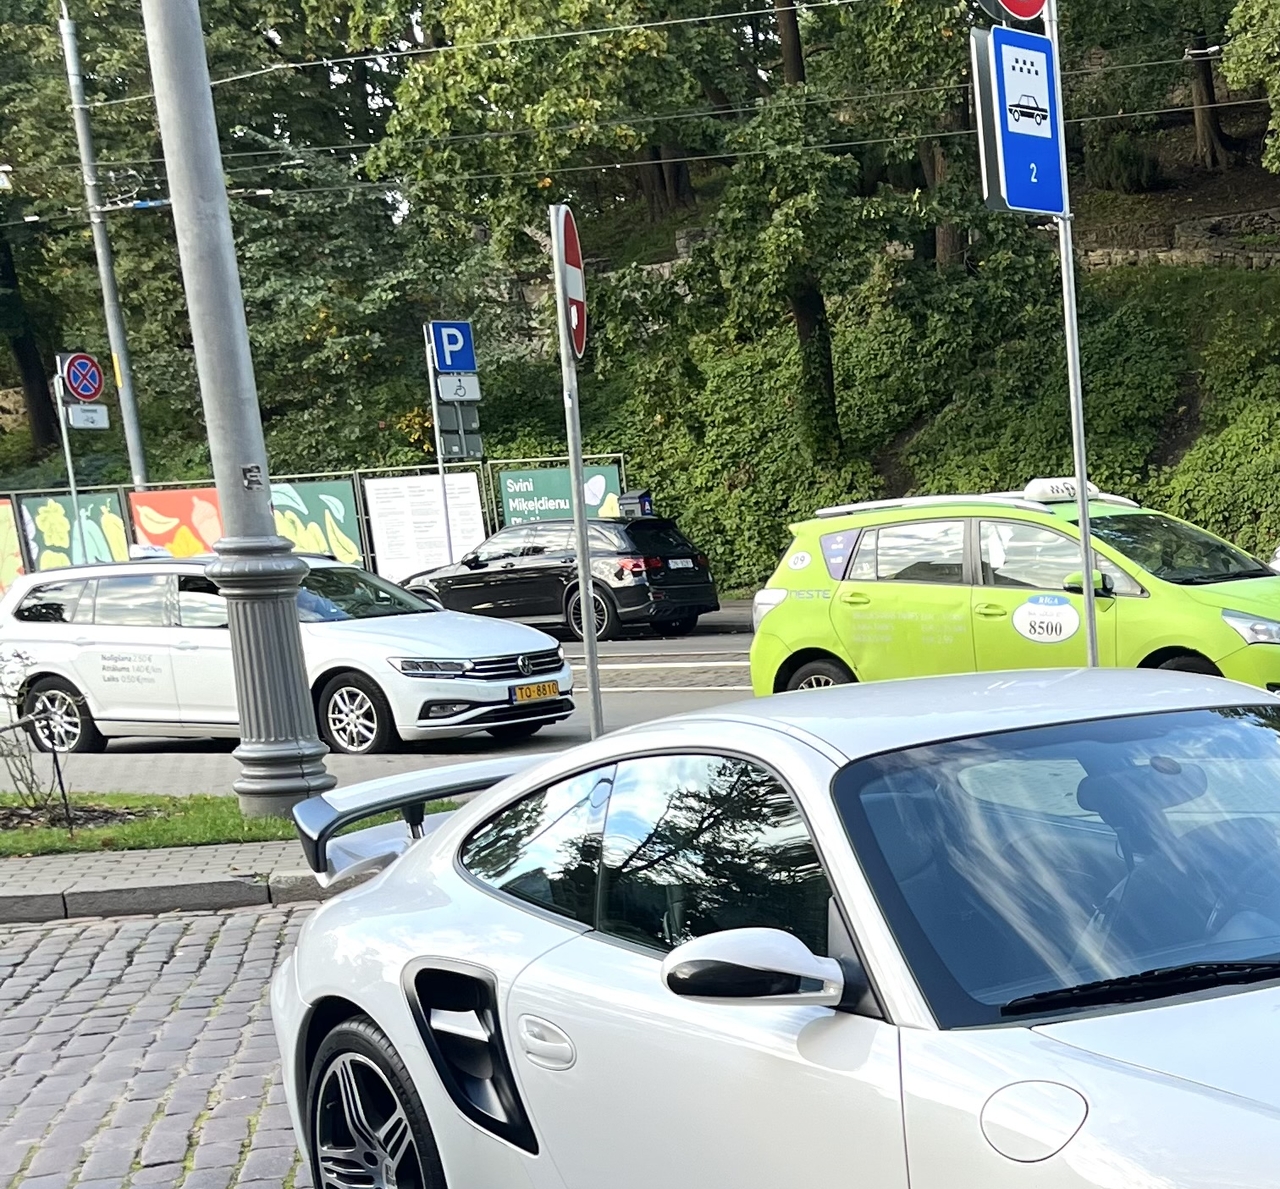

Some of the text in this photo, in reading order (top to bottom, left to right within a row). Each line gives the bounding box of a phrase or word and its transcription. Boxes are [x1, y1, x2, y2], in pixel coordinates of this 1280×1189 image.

[1030, 162, 1038, 183] 2
[441, 327, 464, 366] P
[506, 478, 534, 493] Svini
[508, 497, 570, 514] Miķeļdienu
[793, 555, 806, 566] 09
[1029, 620, 1062, 636] 8500
